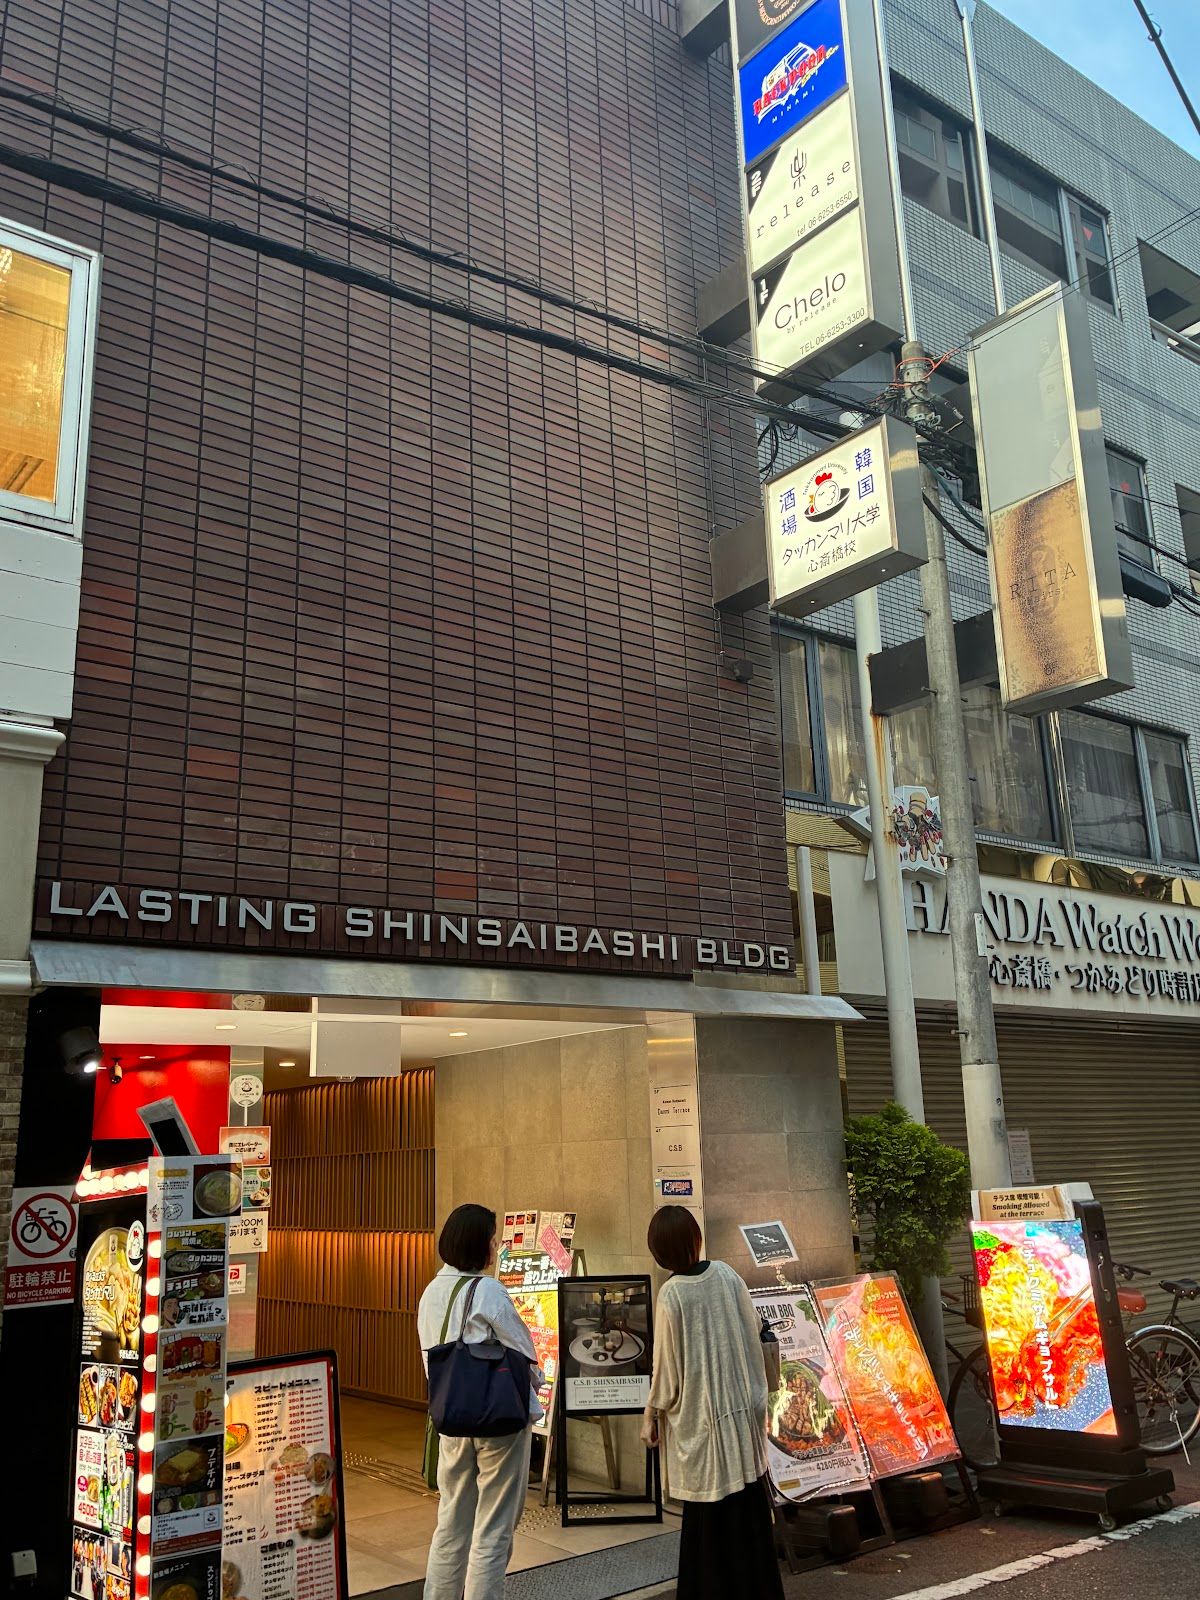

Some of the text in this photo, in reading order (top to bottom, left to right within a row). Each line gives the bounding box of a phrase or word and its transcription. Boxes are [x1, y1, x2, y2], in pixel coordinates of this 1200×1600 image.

[772, 85, 815, 124] MINAMI
[751, 170, 762, 198] 2F
[756, 160, 851, 239] release
[759, 279, 769, 305] 1F
[774, 272, 846, 329] Chelo
[800, 307, 865, 355] TEL 06-6253-3300
[854, 448, 874, 500] 韓国
[779, 488, 797, 536] 酒場
[782, 503, 881, 566] タッカンマリ大学
[807, 540, 857, 573] 心斎橋校
[1009, 562, 1076, 600] RITA
[50, 881, 790, 970] LASTING SHINSAIBASHI BLDG
[1061, 898, 1167, 960] Watch
[992, 1201, 1050, 1211] Smoking Allowed
[1008, 1210, 1019, 1218] the
[9, 1268, 71, 1288] 駐輪禁止
[18, 1289, 43, 1298] BICYCLE
[44, 1287, 71, 1296] PARKING
[777, 1303, 795, 1318] BBQ
[593, 1377, 643, 1386] SHINSAIBASHI
